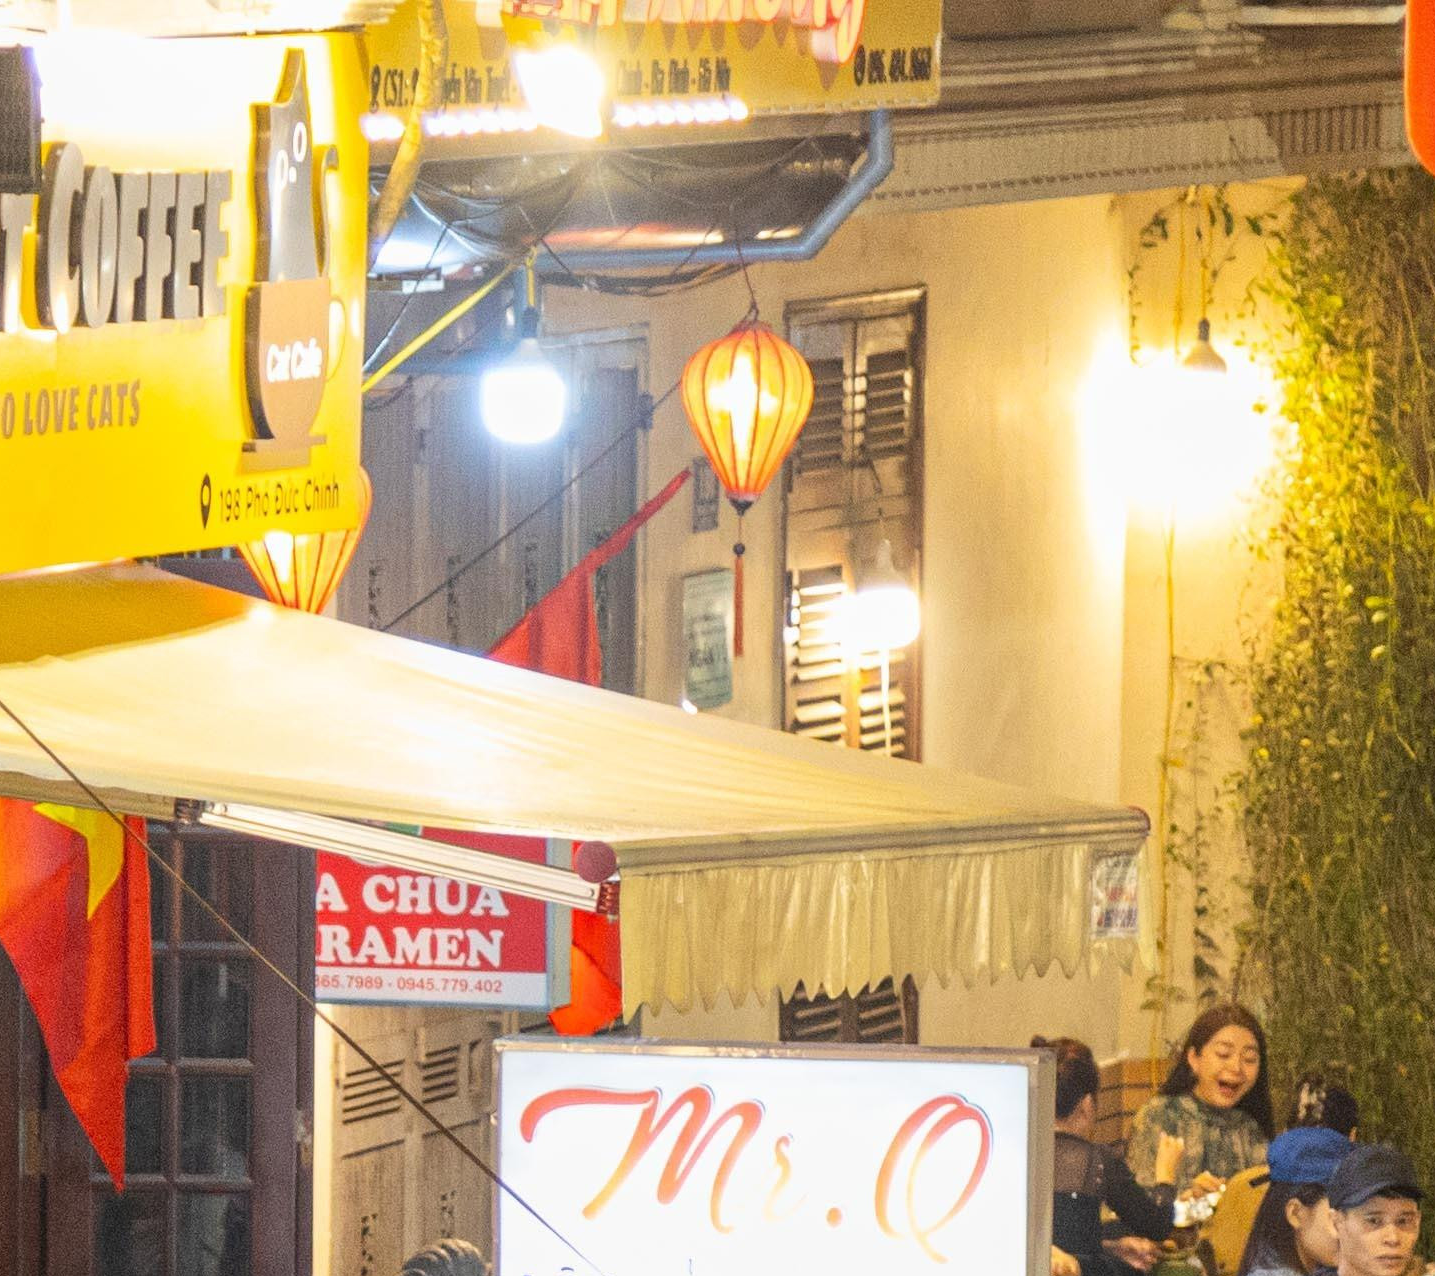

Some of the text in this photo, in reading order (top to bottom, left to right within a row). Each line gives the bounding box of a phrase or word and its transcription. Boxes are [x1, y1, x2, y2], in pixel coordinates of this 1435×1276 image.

[36, 141, 233, 333] COFFEE
[266, 343, 291, 383] Cat
[23, 384, 80, 437] LOVE
[86, 379, 143, 430] CATS
[219, 487, 241, 522] 198
[315, 924, 505, 969] RAMEN
[396, 975, 503, 993] 0945.779.402
[874, 1092, 994, 1264] Q
